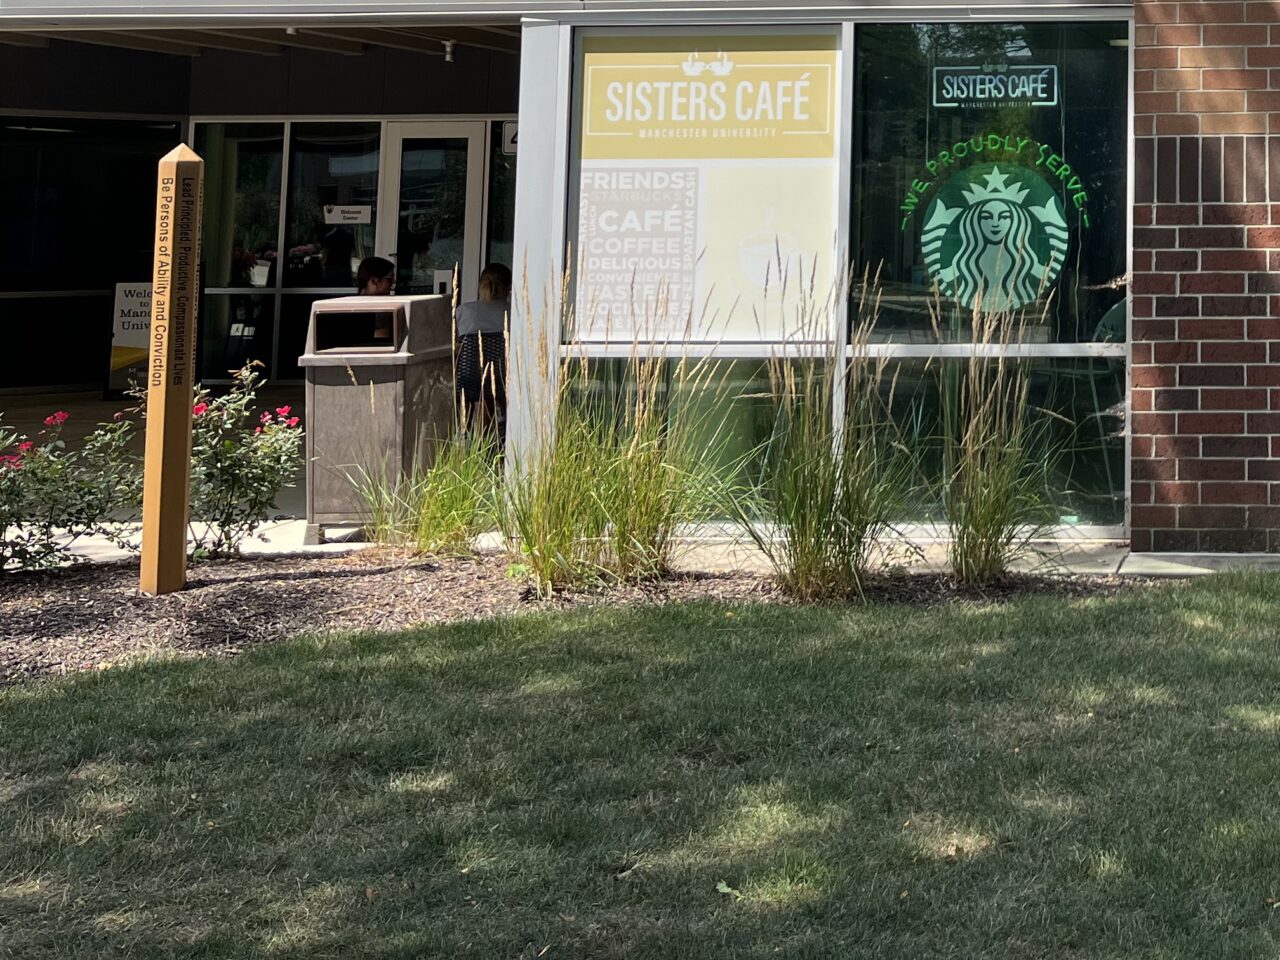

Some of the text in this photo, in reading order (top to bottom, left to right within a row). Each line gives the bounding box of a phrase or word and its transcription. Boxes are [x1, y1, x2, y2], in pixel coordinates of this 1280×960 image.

[605, 72, 812, 122] SISTERS CAFÉ
[941, 70, 1048, 99] SISTERS CAFÉ
[638, 127, 777, 139] MANCHESTER UNIVERSITY
[581, 171, 685, 190] FRIENDS
[901, 134, 1090, 213] WE PROUDLY SERVE
[181, 177, 195, 198] Lead
[591, 190, 683, 202] STARBUCKS
[685, 171, 696, 208] CASH
[589, 205, 598, 236] LUNCH
[598, 203, 682, 232] CAFÉ
[589, 237, 681, 254] COFFEE
[683, 210, 695, 270] SPARTAN
[588, 257, 681, 270] DELICIOUS
[152, 177, 174, 387] Be Persons of Ability and Conviction
[587, 284, 681, 301] FASTET
[586, 302, 680, 316] SOCIALIE
[174, 295, 190, 363] Compassionate
[173, 364, 186, 386] Lives
